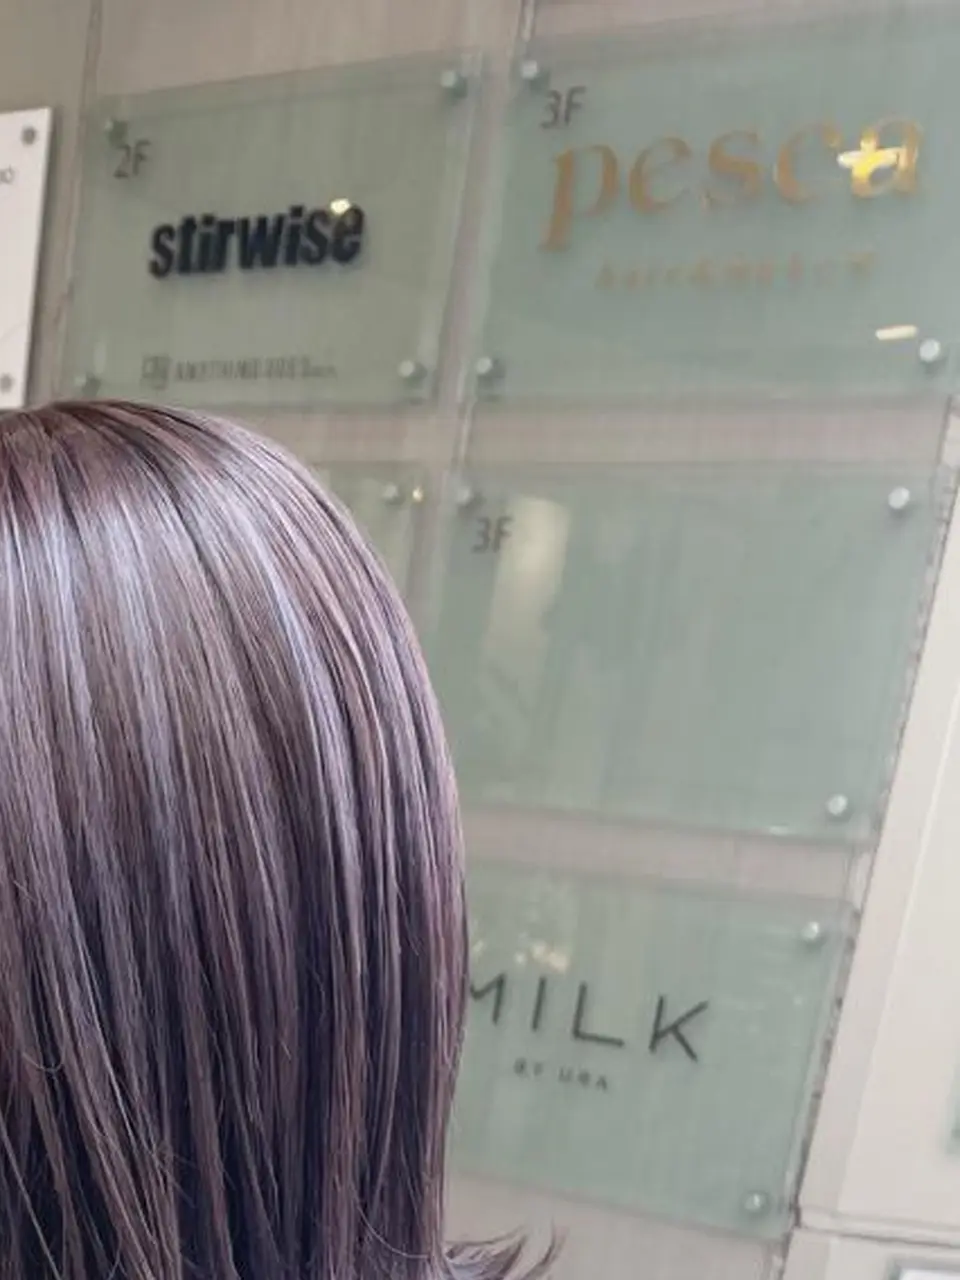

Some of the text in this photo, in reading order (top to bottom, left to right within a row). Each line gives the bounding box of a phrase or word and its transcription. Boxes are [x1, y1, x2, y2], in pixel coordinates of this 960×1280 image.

[541, 86, 586, 130] 3F
[113, 139, 152, 179] 2F
[538, 118, 922, 252] pesca
[148, 203, 366, 280] stirwise
[471, 515, 515, 555] 3F
